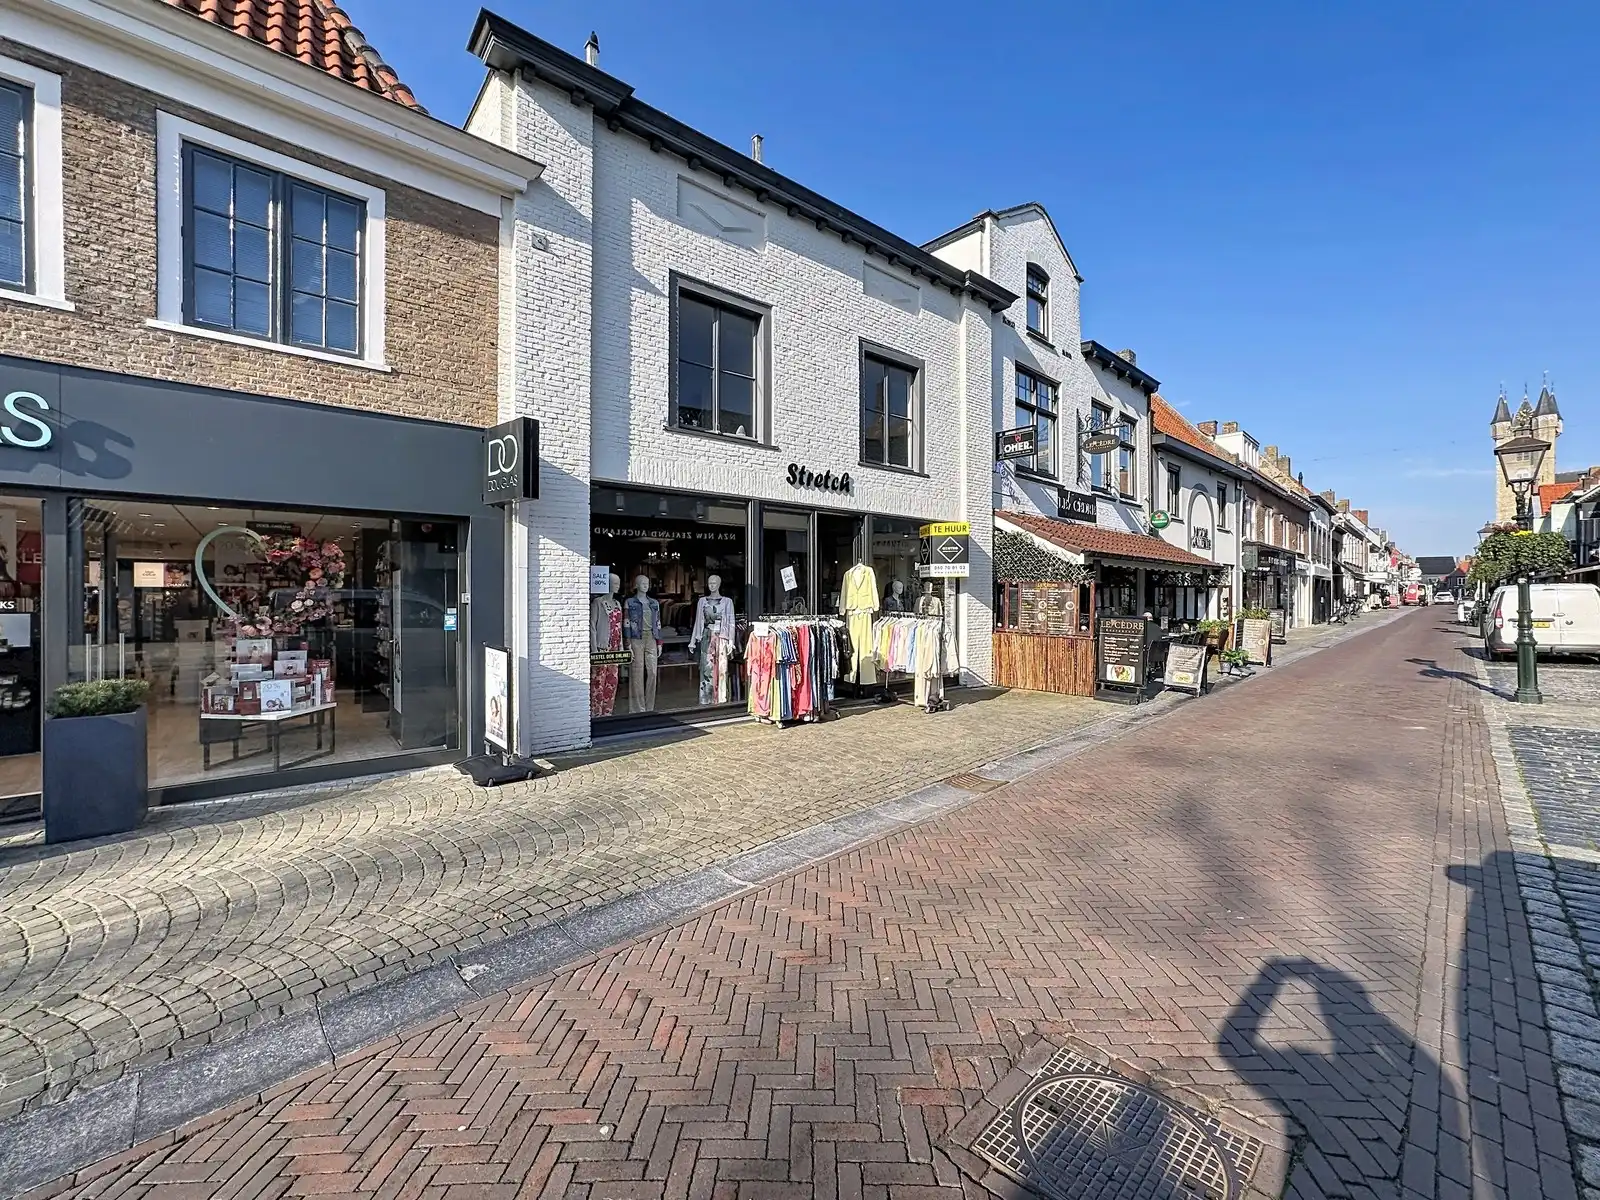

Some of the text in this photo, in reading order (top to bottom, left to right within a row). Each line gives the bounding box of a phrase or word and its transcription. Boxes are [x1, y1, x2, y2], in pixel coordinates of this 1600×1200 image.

[0, 391, 52, 448] S
[786, 463, 851, 493] Stretch
[933, 525, 942, 533] TE
[944, 525, 967, 533] HUUR
